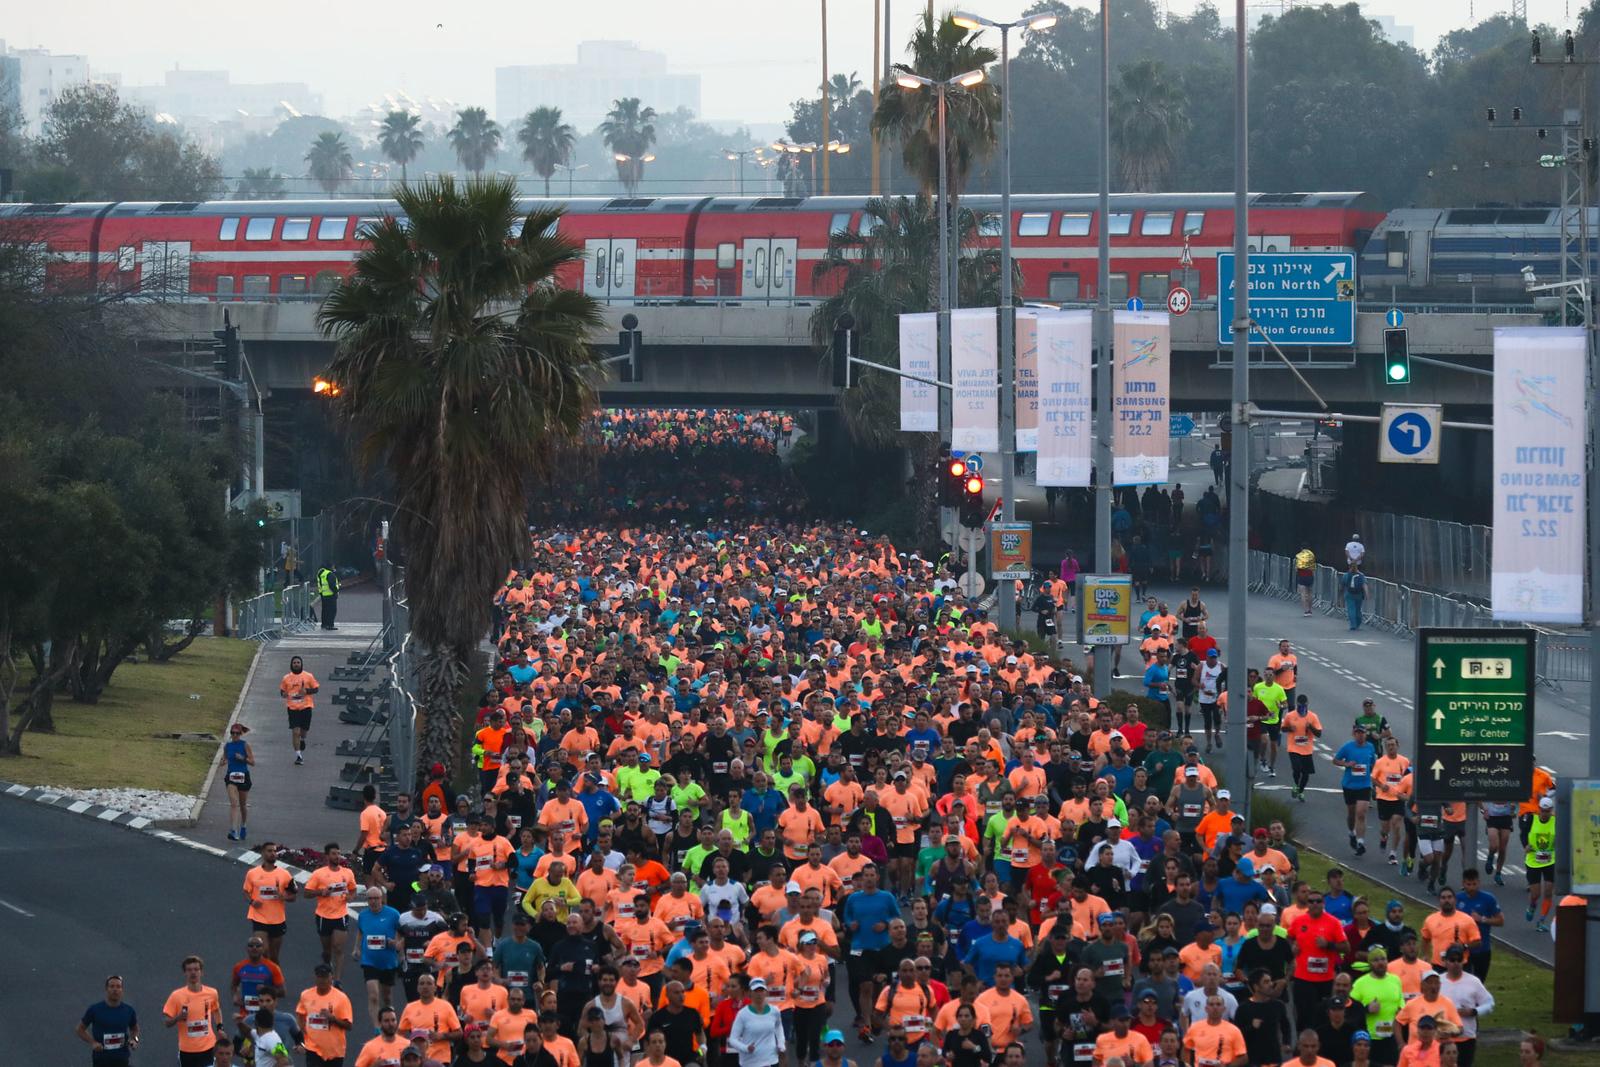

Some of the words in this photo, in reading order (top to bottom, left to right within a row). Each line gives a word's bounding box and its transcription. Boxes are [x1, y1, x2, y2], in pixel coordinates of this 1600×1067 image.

[1248, 263, 1266, 274] צפ
[1273, 262, 1312, 276] איילון
[1229, 280, 1275, 290] Aalon
[1281, 280, 1321, 290] North
[1171, 297, 1187, 306] 4.4
[1248, 307, 1289, 318] הירידי
[1295, 307, 1326, 319] מרכז
[1228, 325, 1285, 334] Eibtion
[1289, 325, 1335, 335] Grounds
[1019, 369, 1035, 378] TEL
[1123, 381, 1157, 393] מרתון
[1115, 397, 1166, 407] SAMSUNG
[1128, 424, 1152, 437] 22.2
[1448, 701, 1490, 711] הירידים
[1494, 701, 1523, 711] מרכז
[1460, 728, 1476, 738] Fair
[1480, 728, 1510, 738] Center
[1460, 752, 1491, 762] יהושע
[1495, 752, 1510, 762] גני
[1448, 778, 1475, 787] Ganei
[1477, 778, 1521, 788] Yehoshua
